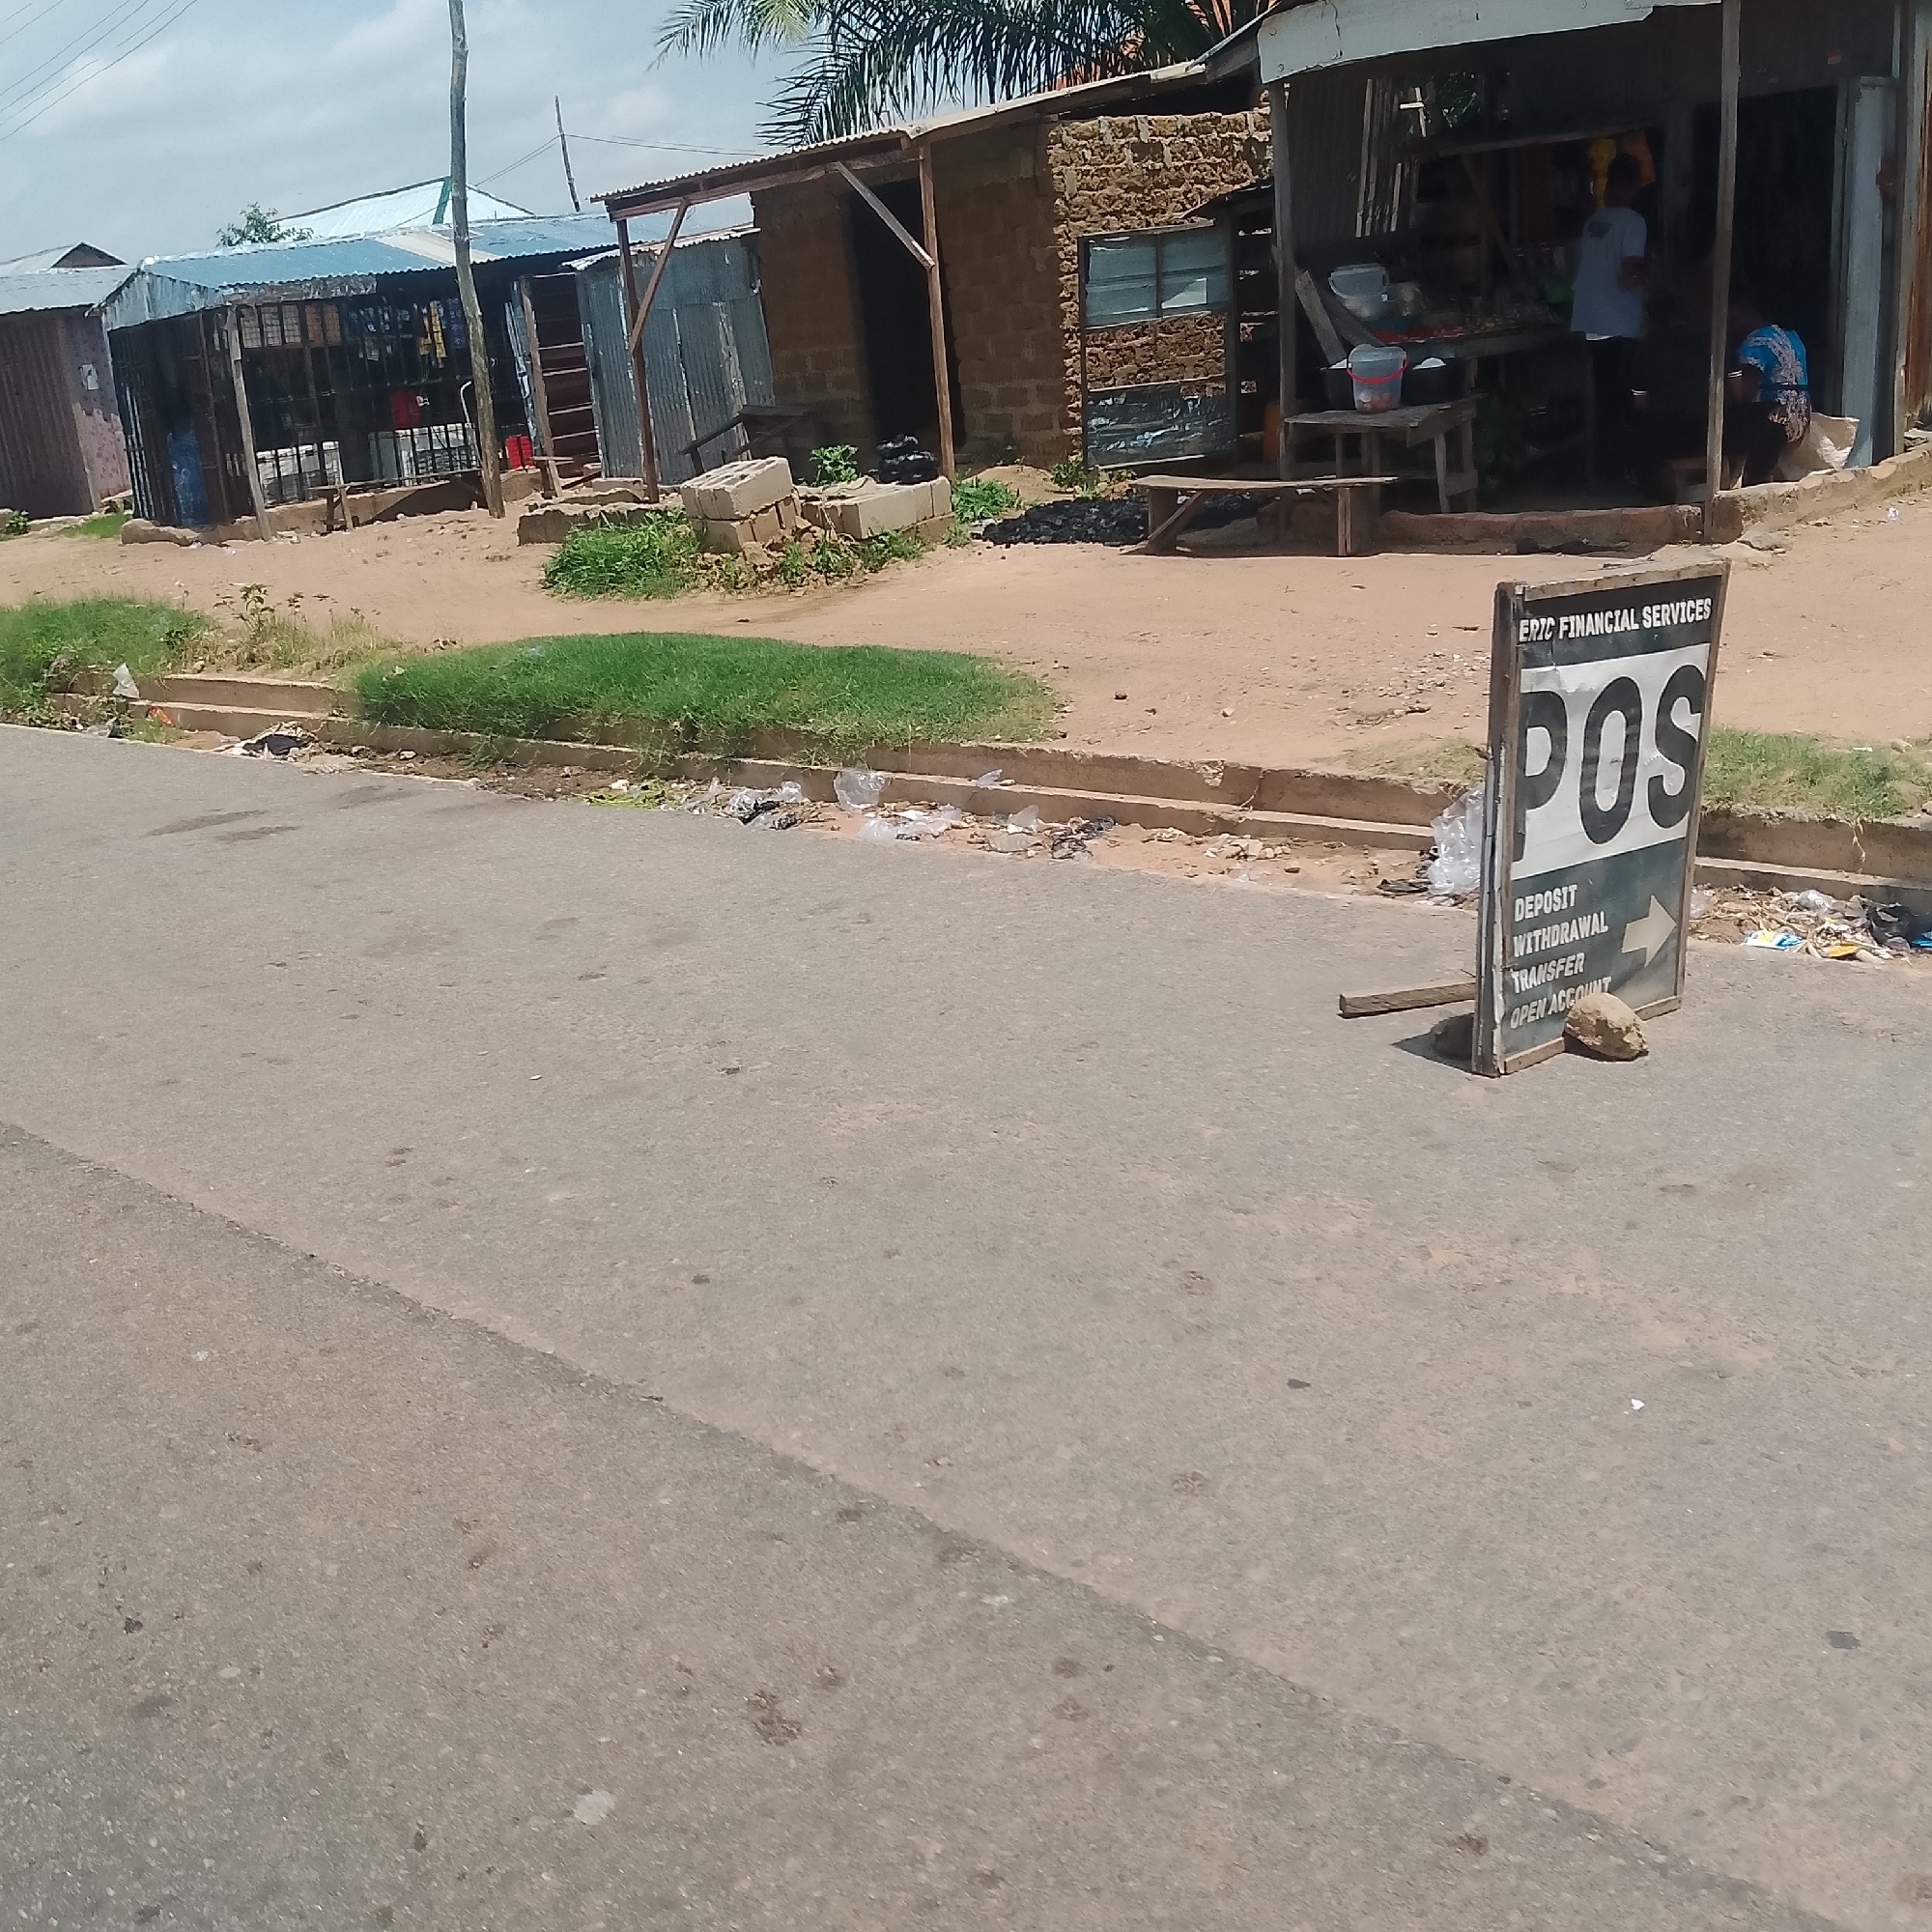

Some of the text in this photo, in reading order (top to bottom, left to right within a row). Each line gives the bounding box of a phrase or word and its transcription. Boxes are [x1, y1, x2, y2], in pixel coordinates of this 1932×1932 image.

[1519, 598, 1712, 642] ERIC FINANCIAL SERVICES
[1513, 665, 1706, 862] POS
[1514, 884, 1578, 923] DEPOSIT
[1513, 911, 1609, 958] WITHDRAWAL
[1511, 952, 1586, 994] TRANSFER
[1510, 997, 1548, 1030] OPEN
